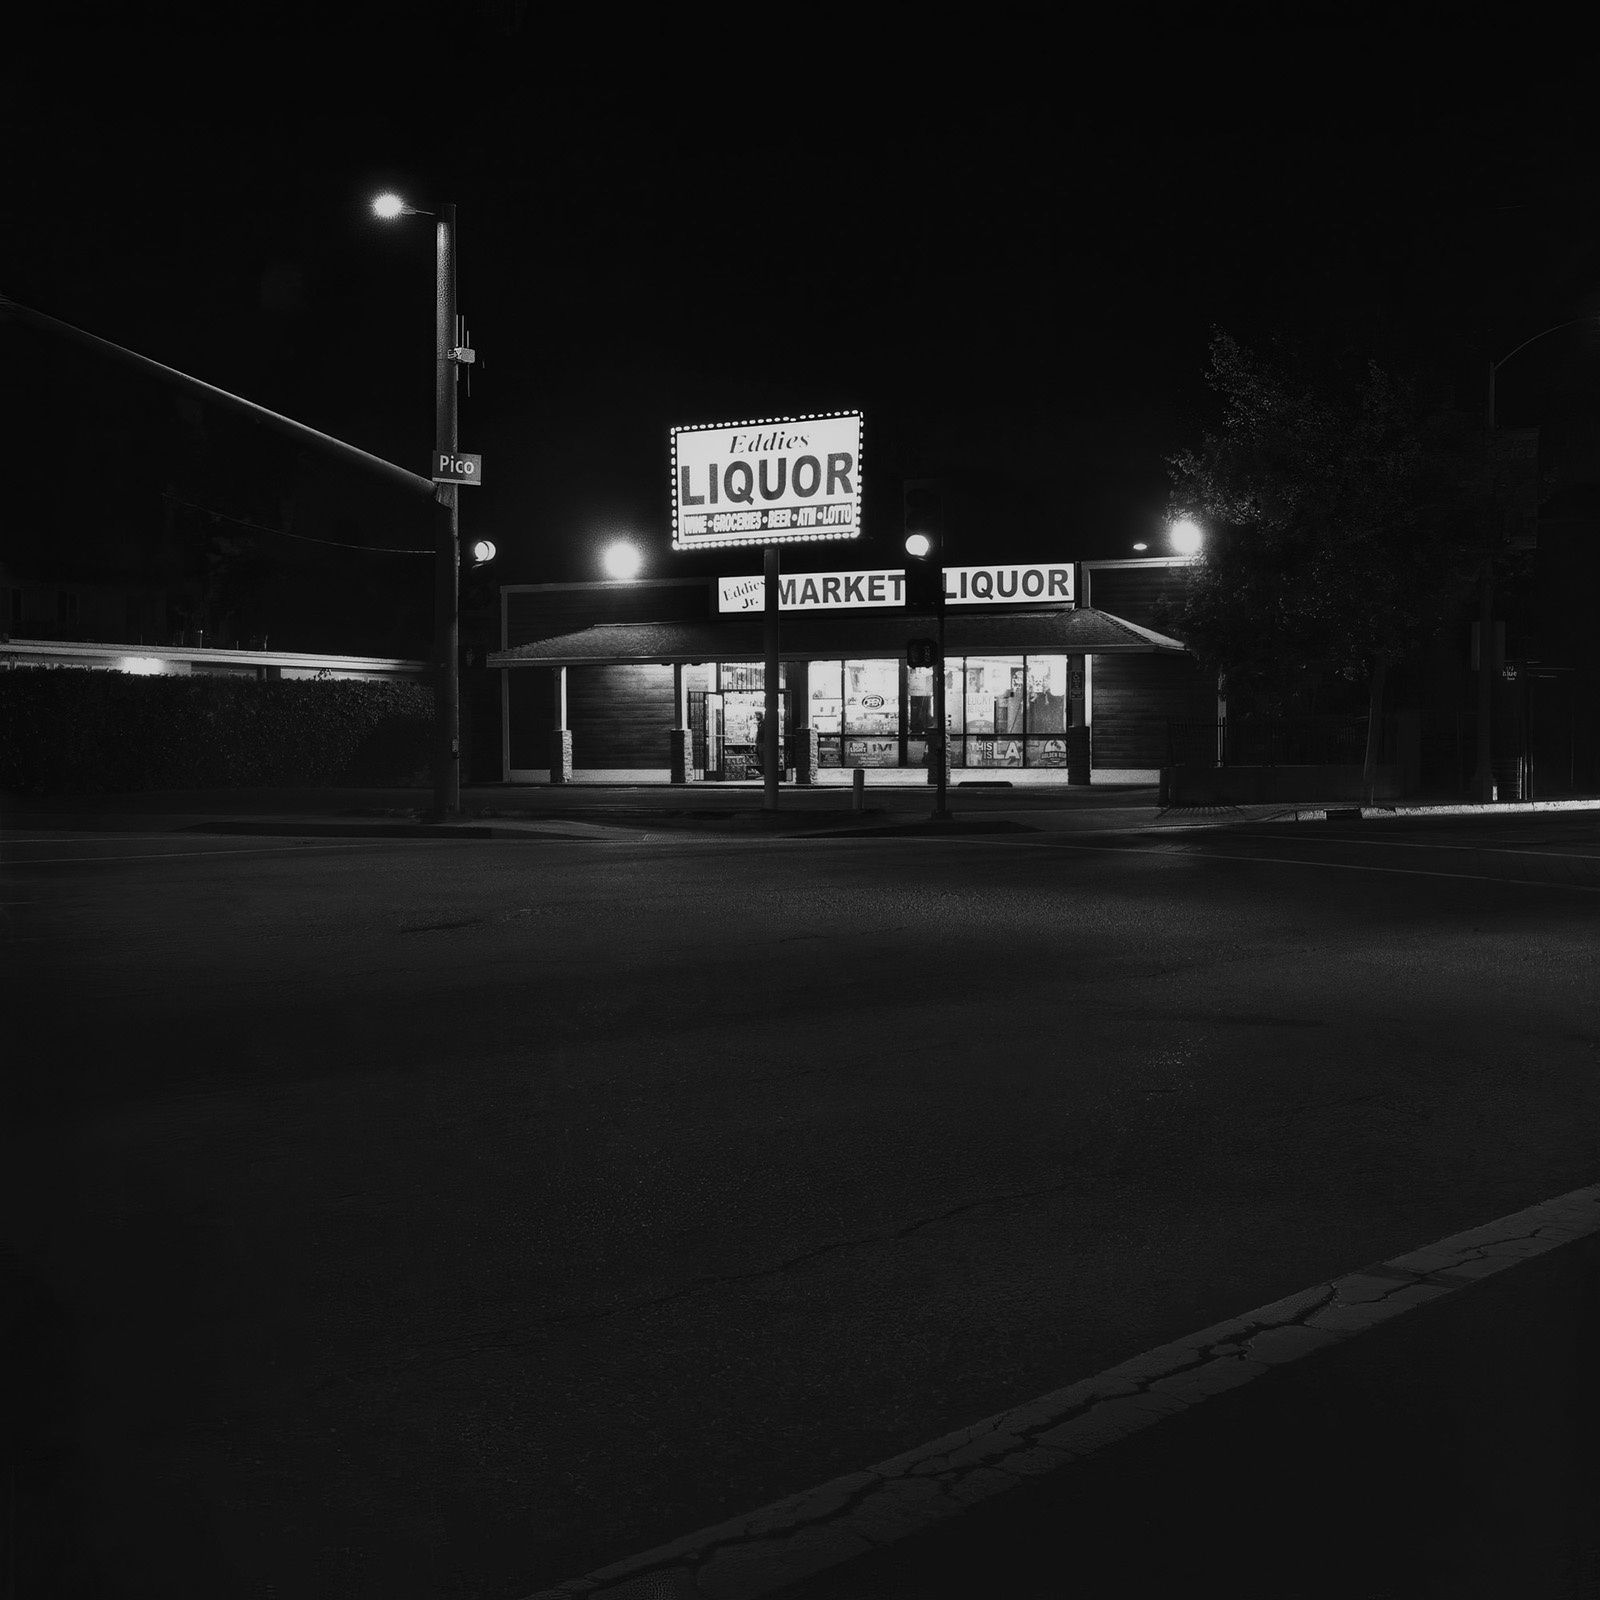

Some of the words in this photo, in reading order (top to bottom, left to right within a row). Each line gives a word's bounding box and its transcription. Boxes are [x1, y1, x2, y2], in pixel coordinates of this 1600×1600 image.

[729, 431, 811, 454] Eddies
[440, 455, 475, 474] Pico
[681, 452, 854, 506] LIQUOR
[713, 511, 762, 532] GROCERIES
[768, 509, 791, 528] BEER
[797, 507, 817, 526] ATM
[823, 504, 851, 524] LOTTO
[778, 574, 906, 605] MARKET
[942, 569, 1070, 600] LIQUOR
[742, 598, 759, 609] Jr.
[970, 741, 993, 751] THIS
[993, 740, 1020, 760] LA
